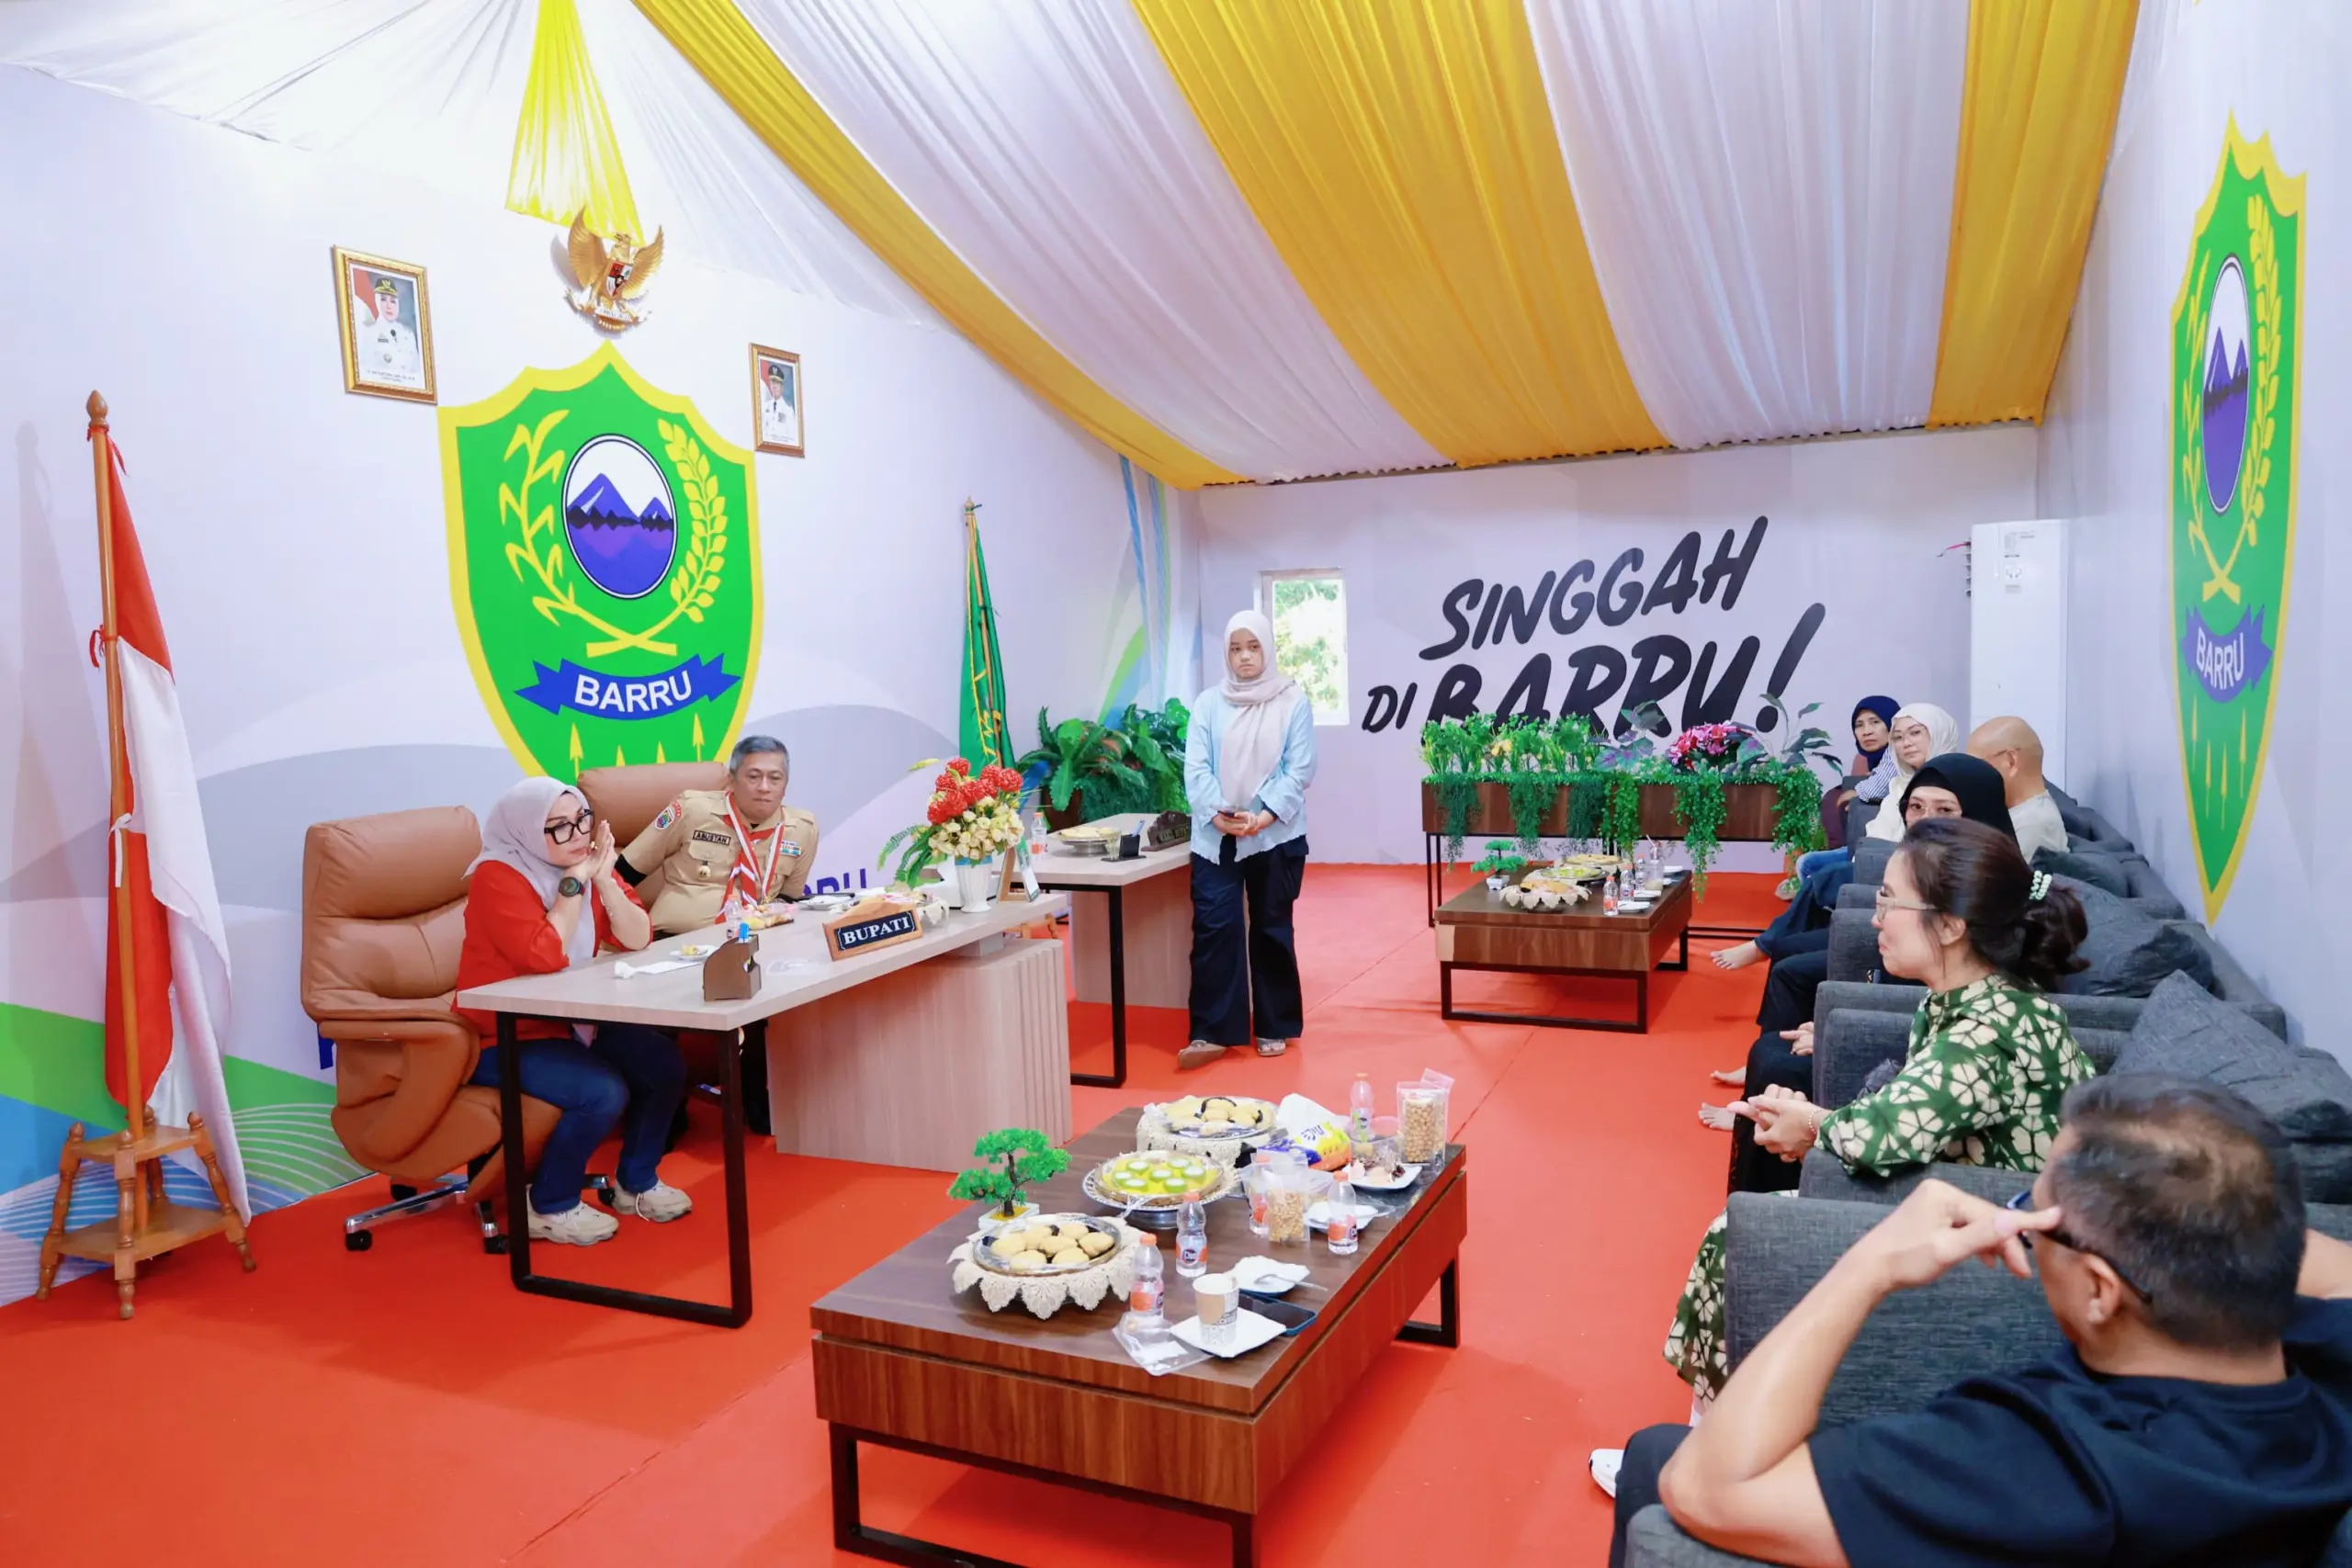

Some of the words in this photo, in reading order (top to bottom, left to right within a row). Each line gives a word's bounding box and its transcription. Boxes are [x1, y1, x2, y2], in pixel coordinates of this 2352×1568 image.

[1419, 515, 1769, 660] SINGGAH
[2196, 626, 2245, 690] BARRU
[574, 670, 692, 713] BARRU
[1362, 682, 1418, 733] DI
[842, 916, 910, 945] BUPATI
